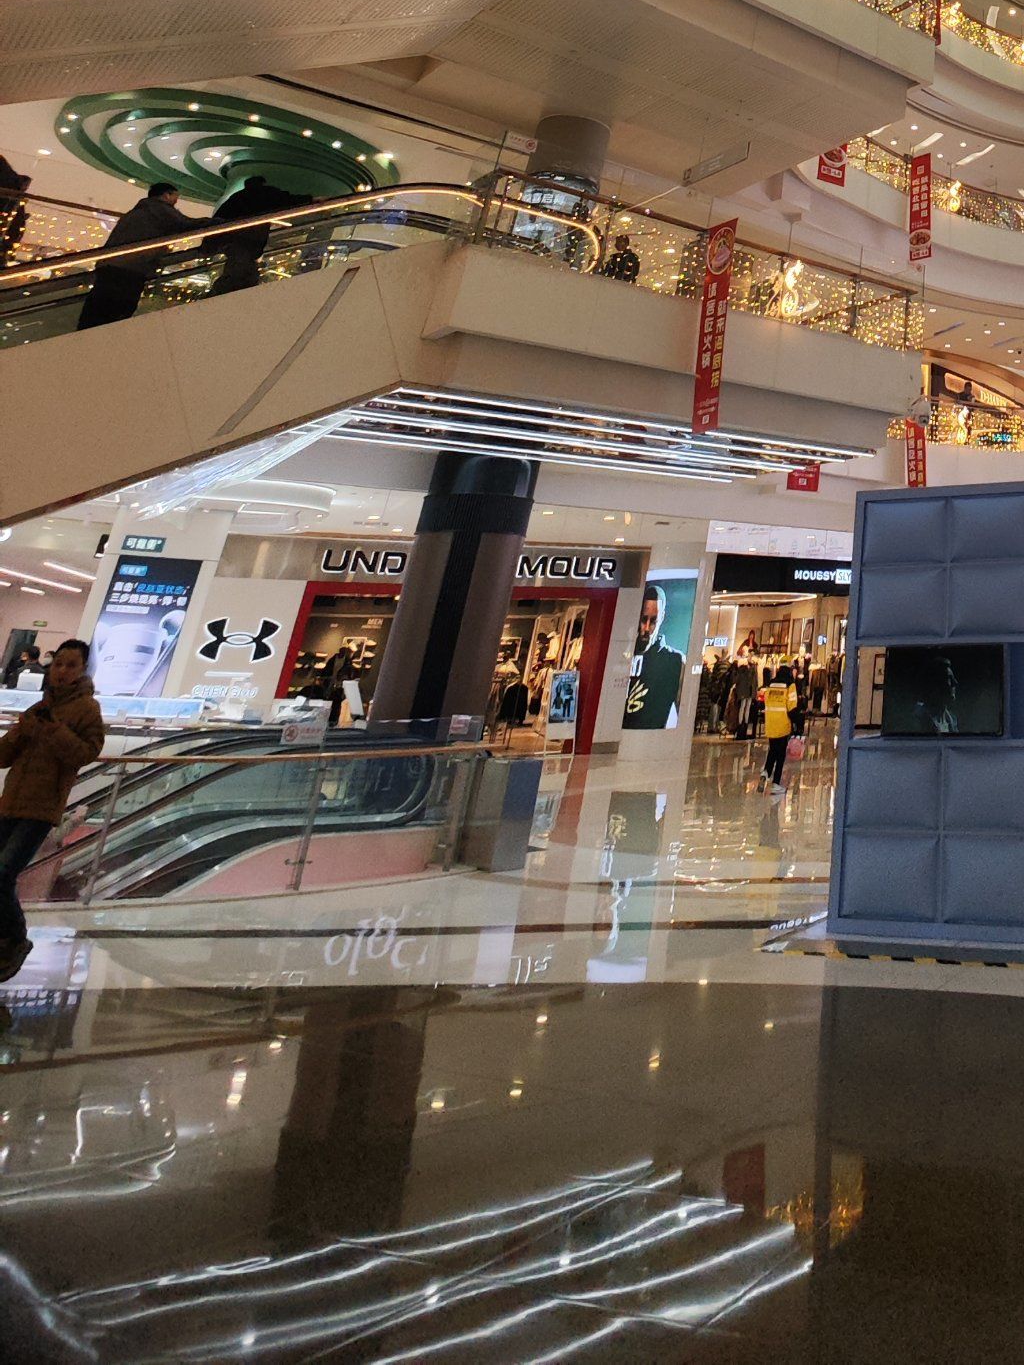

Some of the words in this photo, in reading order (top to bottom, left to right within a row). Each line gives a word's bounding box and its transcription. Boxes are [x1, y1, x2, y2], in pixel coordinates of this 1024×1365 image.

[321, 549, 407, 575] UND
[515, 555, 617, 581] MOUR
[794, 569, 836, 581] MOUSSY
